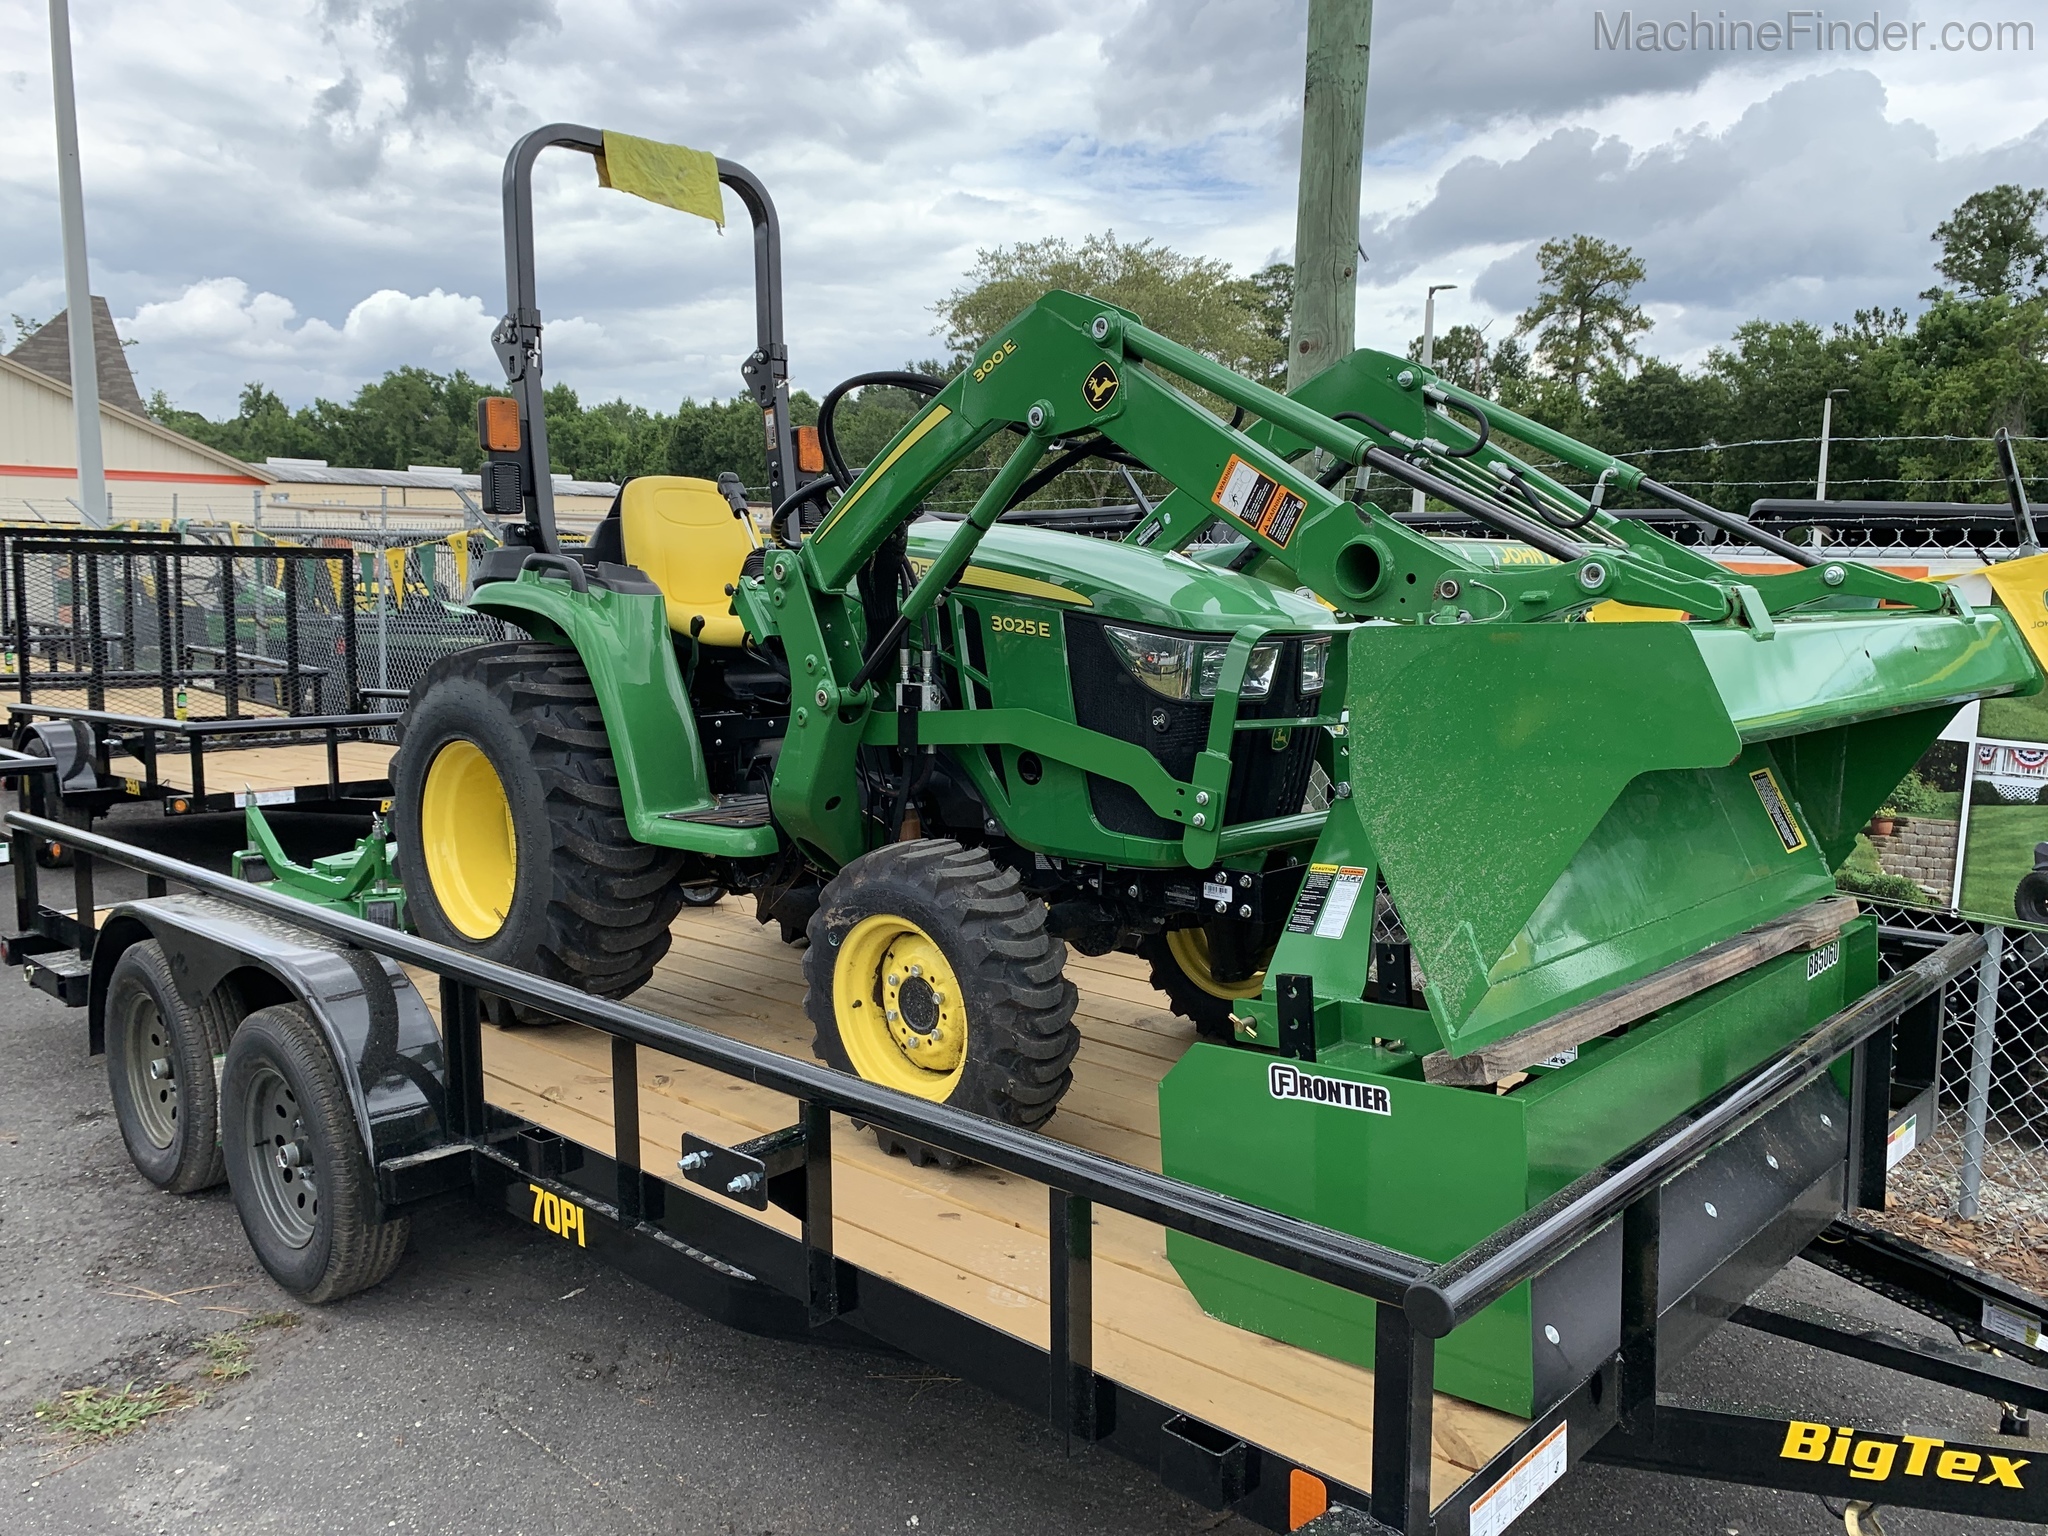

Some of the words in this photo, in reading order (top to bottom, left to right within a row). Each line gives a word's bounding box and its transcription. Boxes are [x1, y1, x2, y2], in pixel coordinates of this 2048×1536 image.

[972, 338, 1018, 383] 300E
[1219, 461, 1235, 490] WARNING
[1267, 492, 1284, 522] WARNING
[1498, 545, 1546, 564] JOHN
[991, 615, 1051, 638] 3025E
[1271, 1064, 1389, 1113] FRONTIER
[529, 1183, 586, 1248] 70PI
